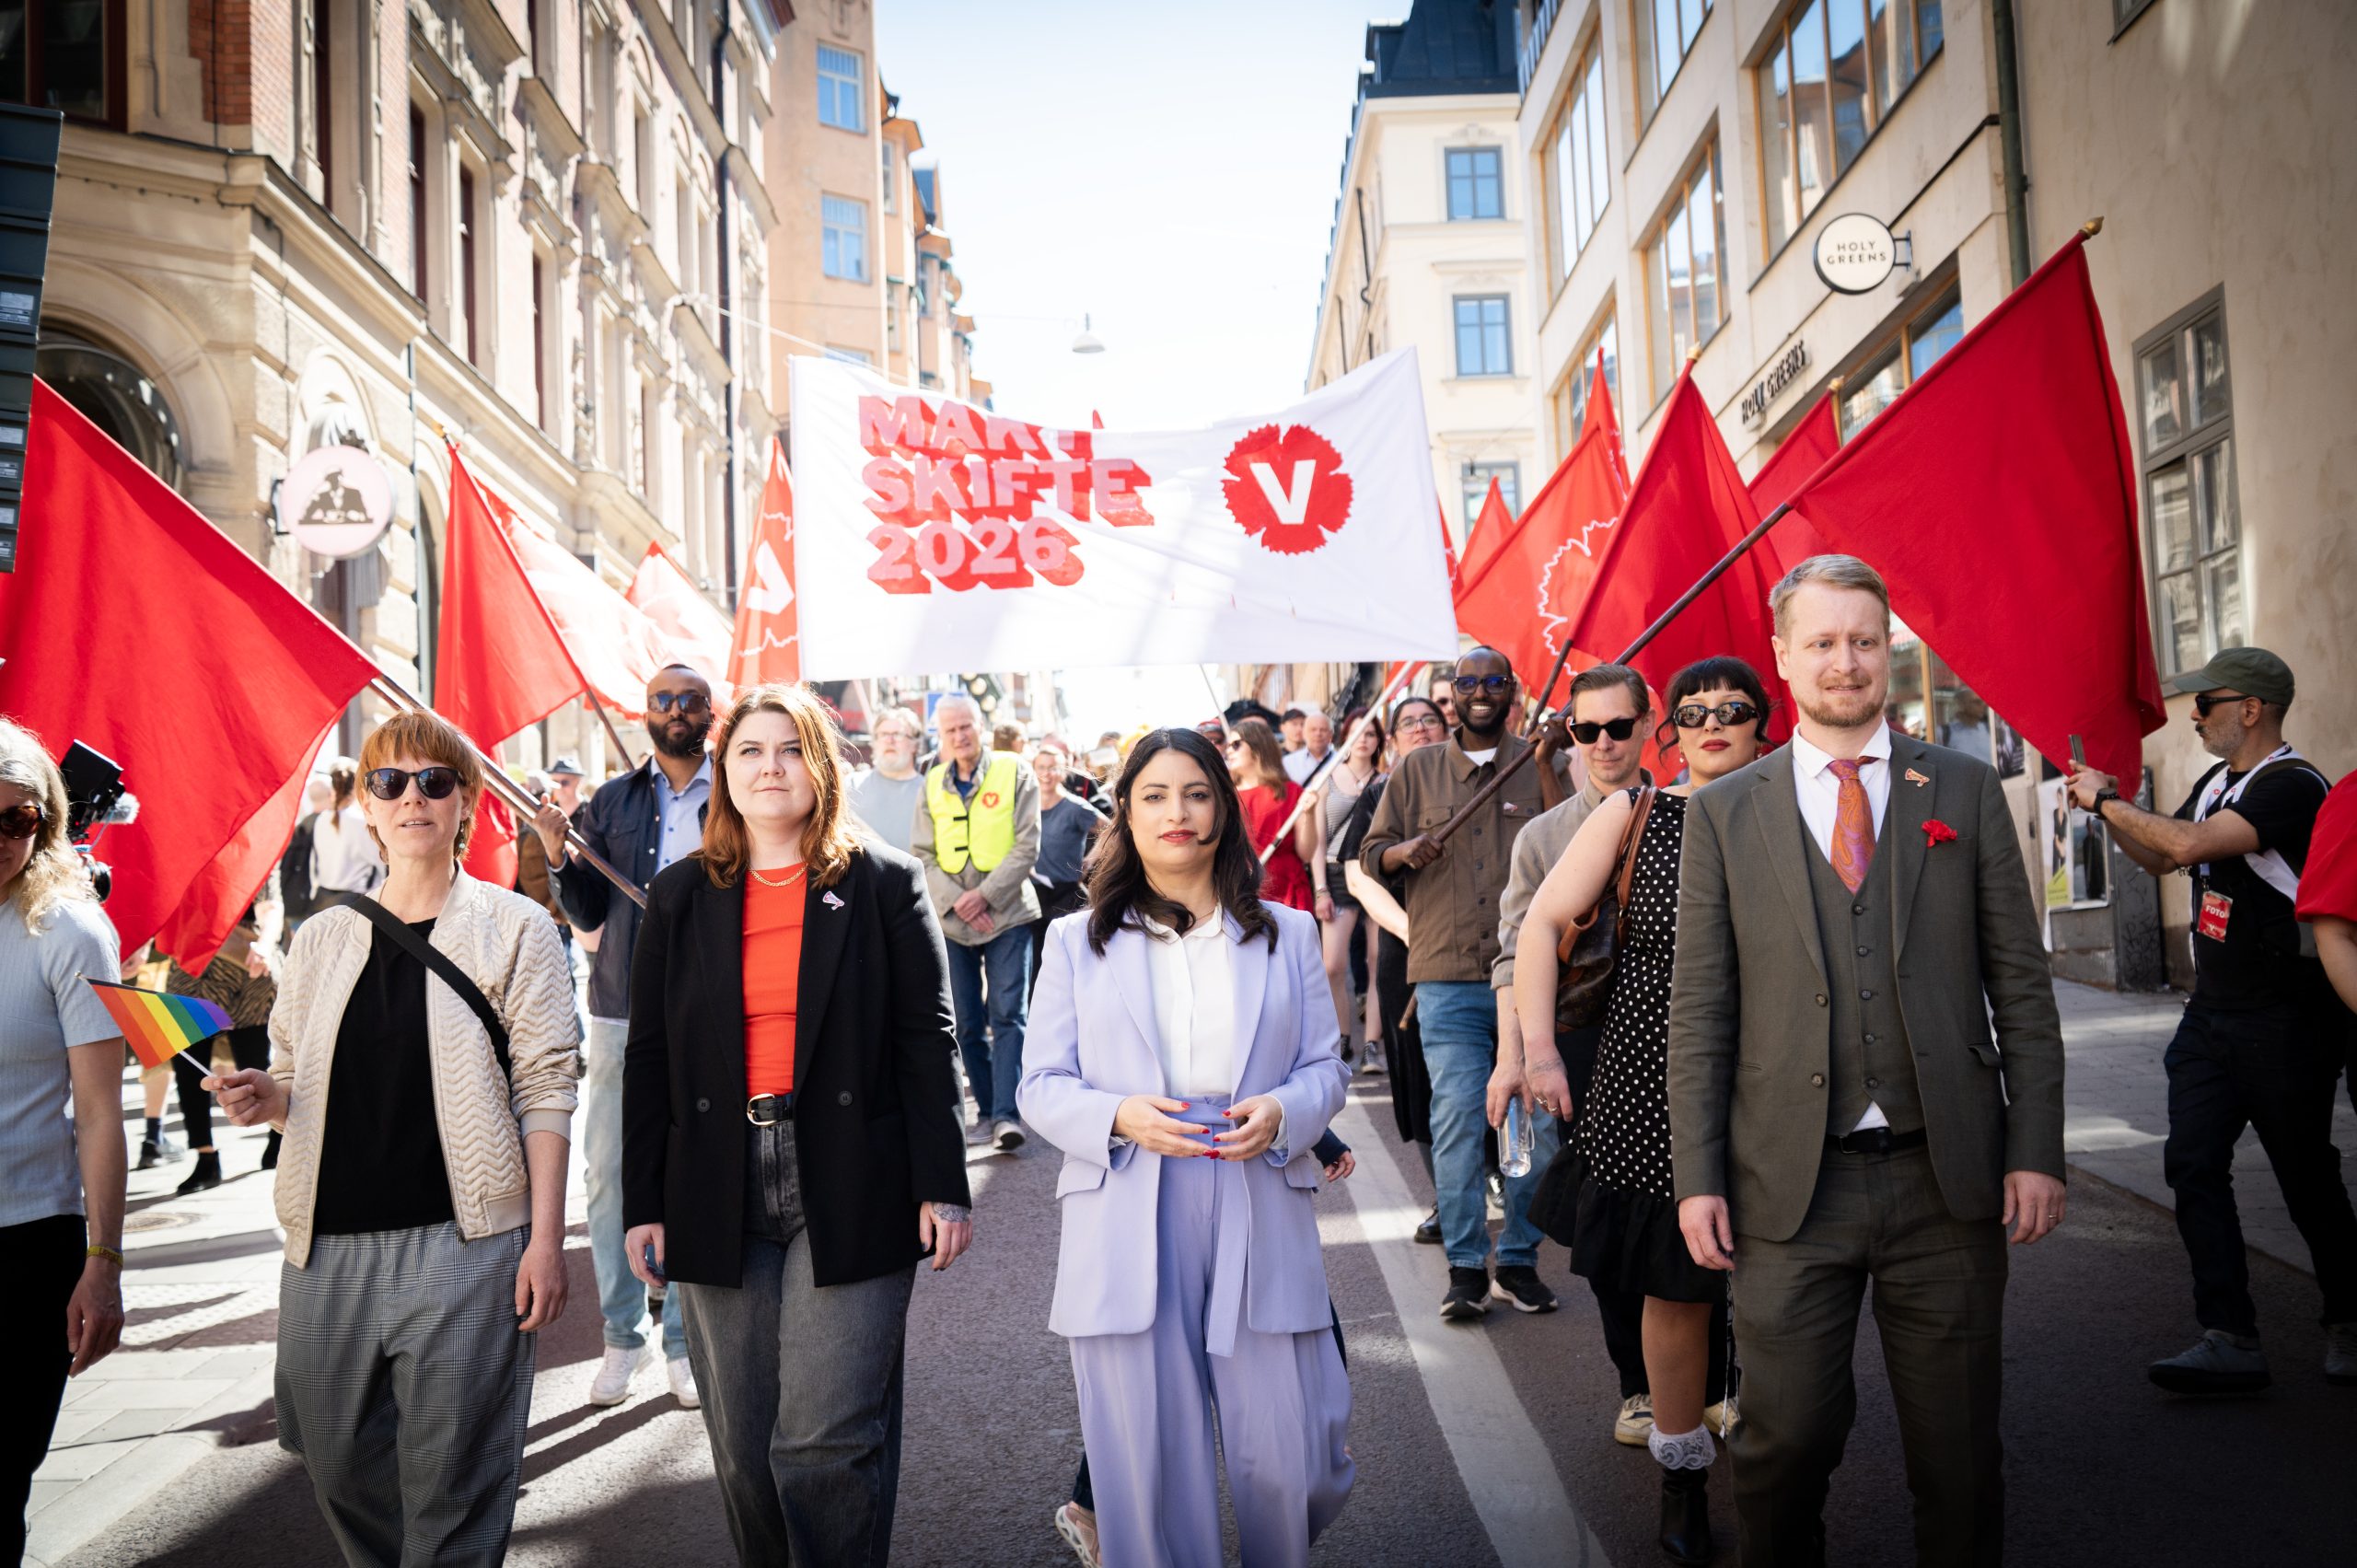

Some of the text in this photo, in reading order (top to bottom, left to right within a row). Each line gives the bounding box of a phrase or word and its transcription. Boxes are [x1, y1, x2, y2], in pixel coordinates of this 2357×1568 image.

[1826, 251, 1887, 265] GREENS
[1836, 241, 1876, 252] HOLY
[862, 456, 1154, 527] SKIFTE
[1248, 459, 1317, 525] V
[865, 517, 1085, 594] 2026
[2205, 904, 2226, 919] FOTO
